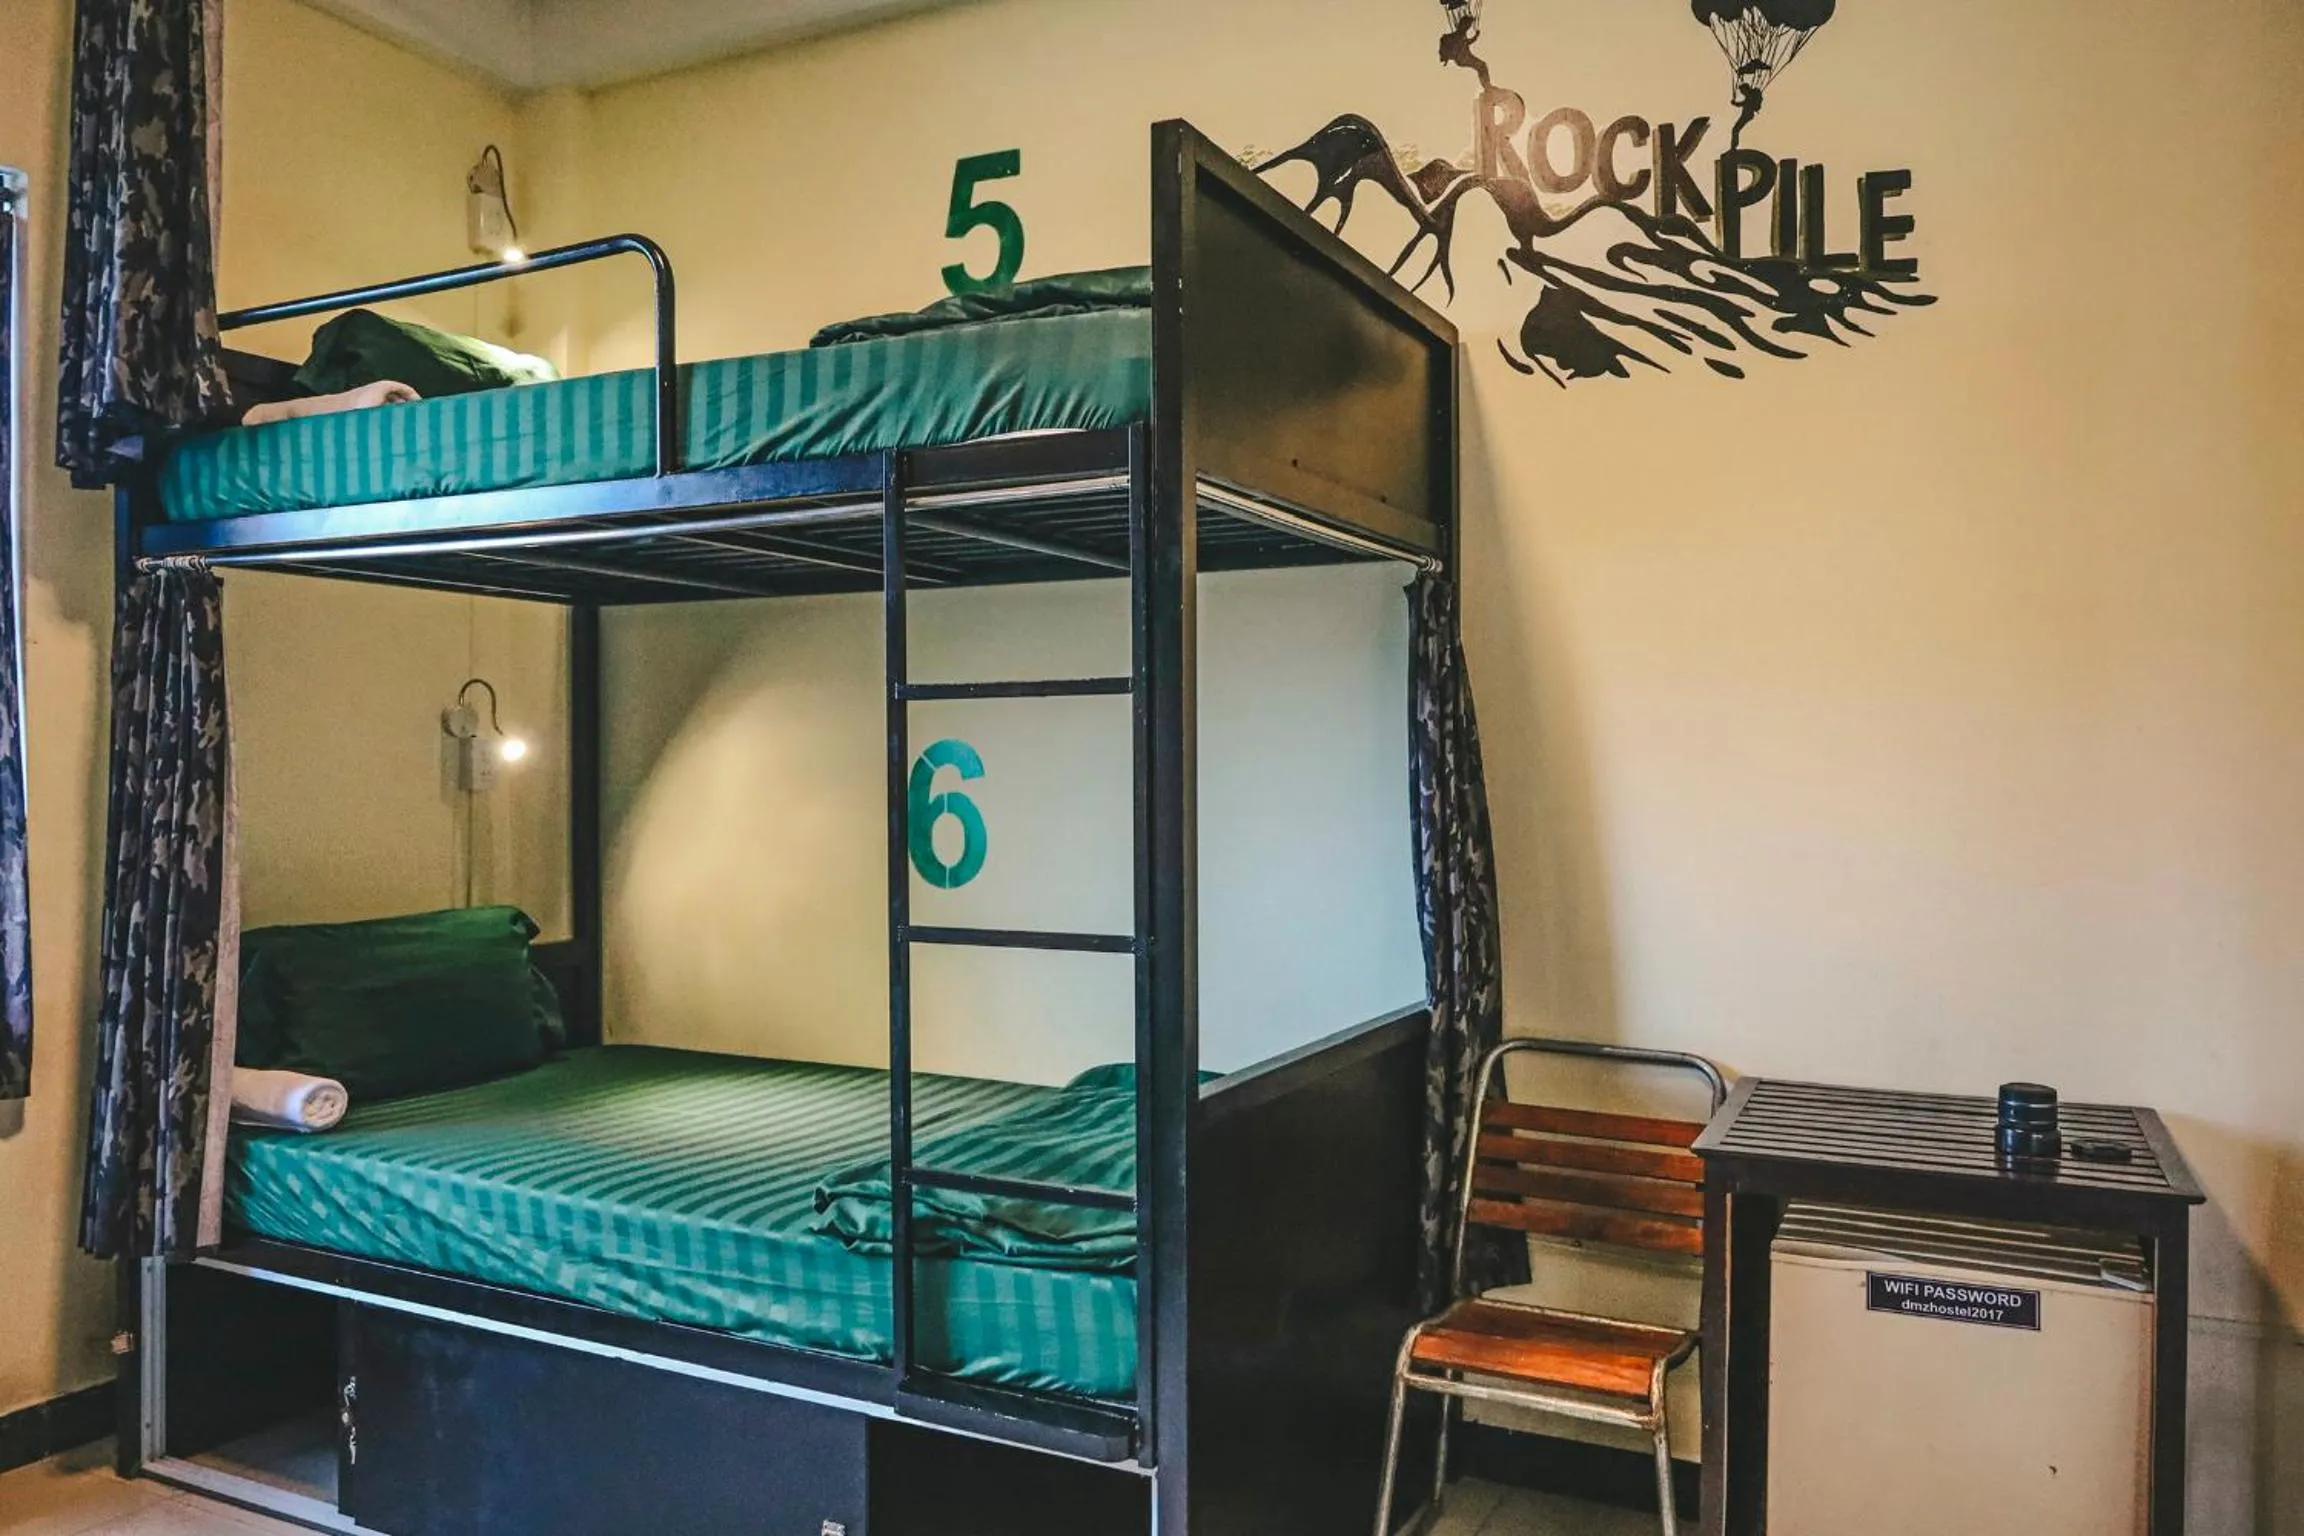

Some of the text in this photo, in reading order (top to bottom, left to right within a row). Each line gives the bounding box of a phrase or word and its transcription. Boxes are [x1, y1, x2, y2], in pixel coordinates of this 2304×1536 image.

[941, 148, 1025, 298] 5
[908, 738, 988, 889] 6
[1884, 1280, 2022, 1308] WIFI PASSWORD
[1901, 1299, 2004, 1321] dmzhostel2017
